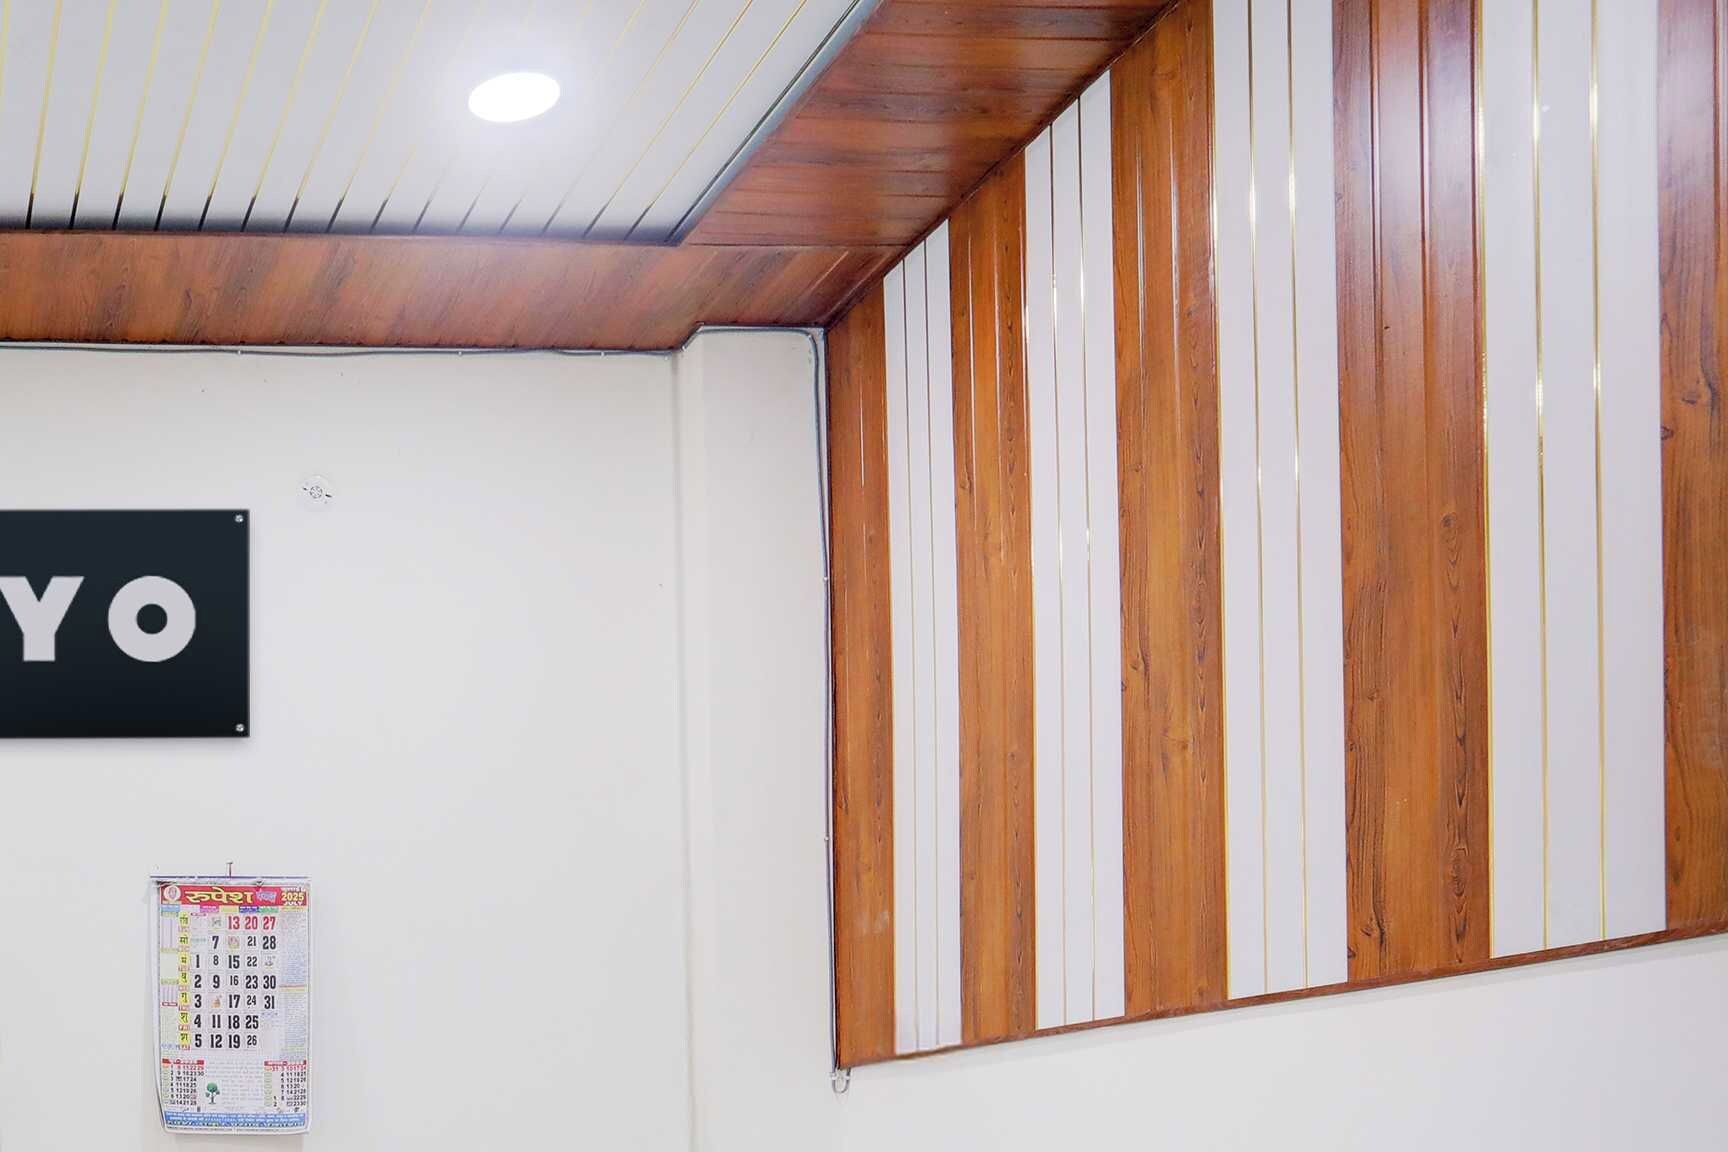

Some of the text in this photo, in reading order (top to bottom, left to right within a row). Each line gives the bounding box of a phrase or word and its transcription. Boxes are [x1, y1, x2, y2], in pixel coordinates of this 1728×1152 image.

[281, 892, 305, 901] 2025
[228, 916, 276, 930] 13 20 27
[212, 936, 276, 950] 7 21 28
[196, 955, 257, 969] 1 8 15 22
[194, 974, 276, 989] 2 9 16 23 30
[194, 994, 275, 1009] 3 17 24 31
[194, 1014, 258, 1029] 4 11 18 25
[195, 1034, 257, 1049] 5 12 19 26
